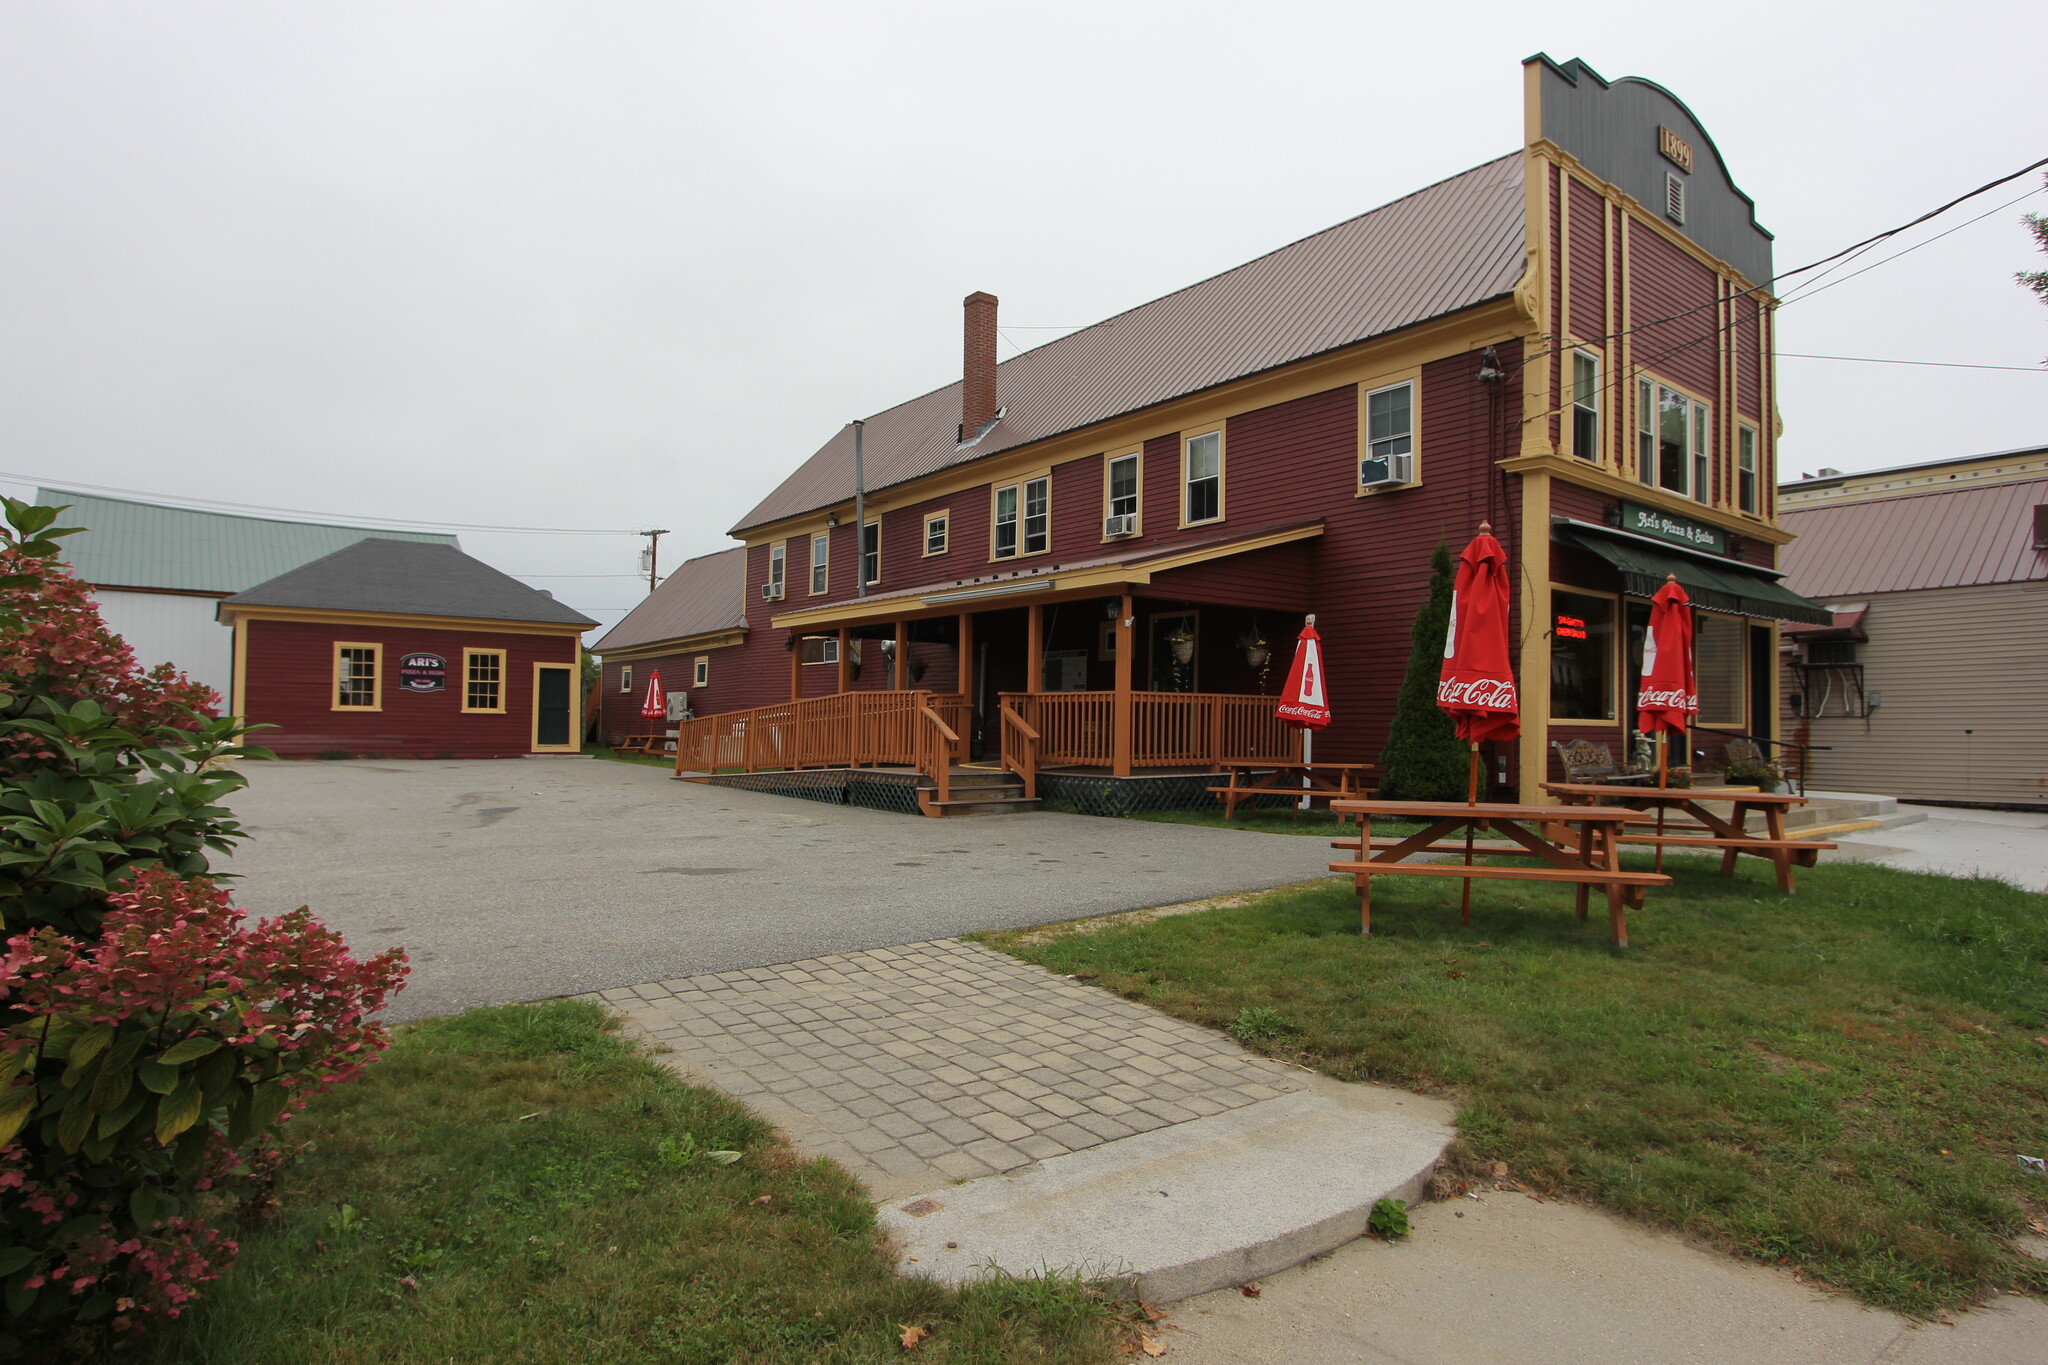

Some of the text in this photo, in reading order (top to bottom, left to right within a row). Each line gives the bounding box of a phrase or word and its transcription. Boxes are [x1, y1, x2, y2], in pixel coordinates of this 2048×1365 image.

[1664, 130, 1690, 167] 1899
[1637, 511, 1714, 545] Ari's Pizza & Subs
[408, 657, 439, 667] ARI'S
